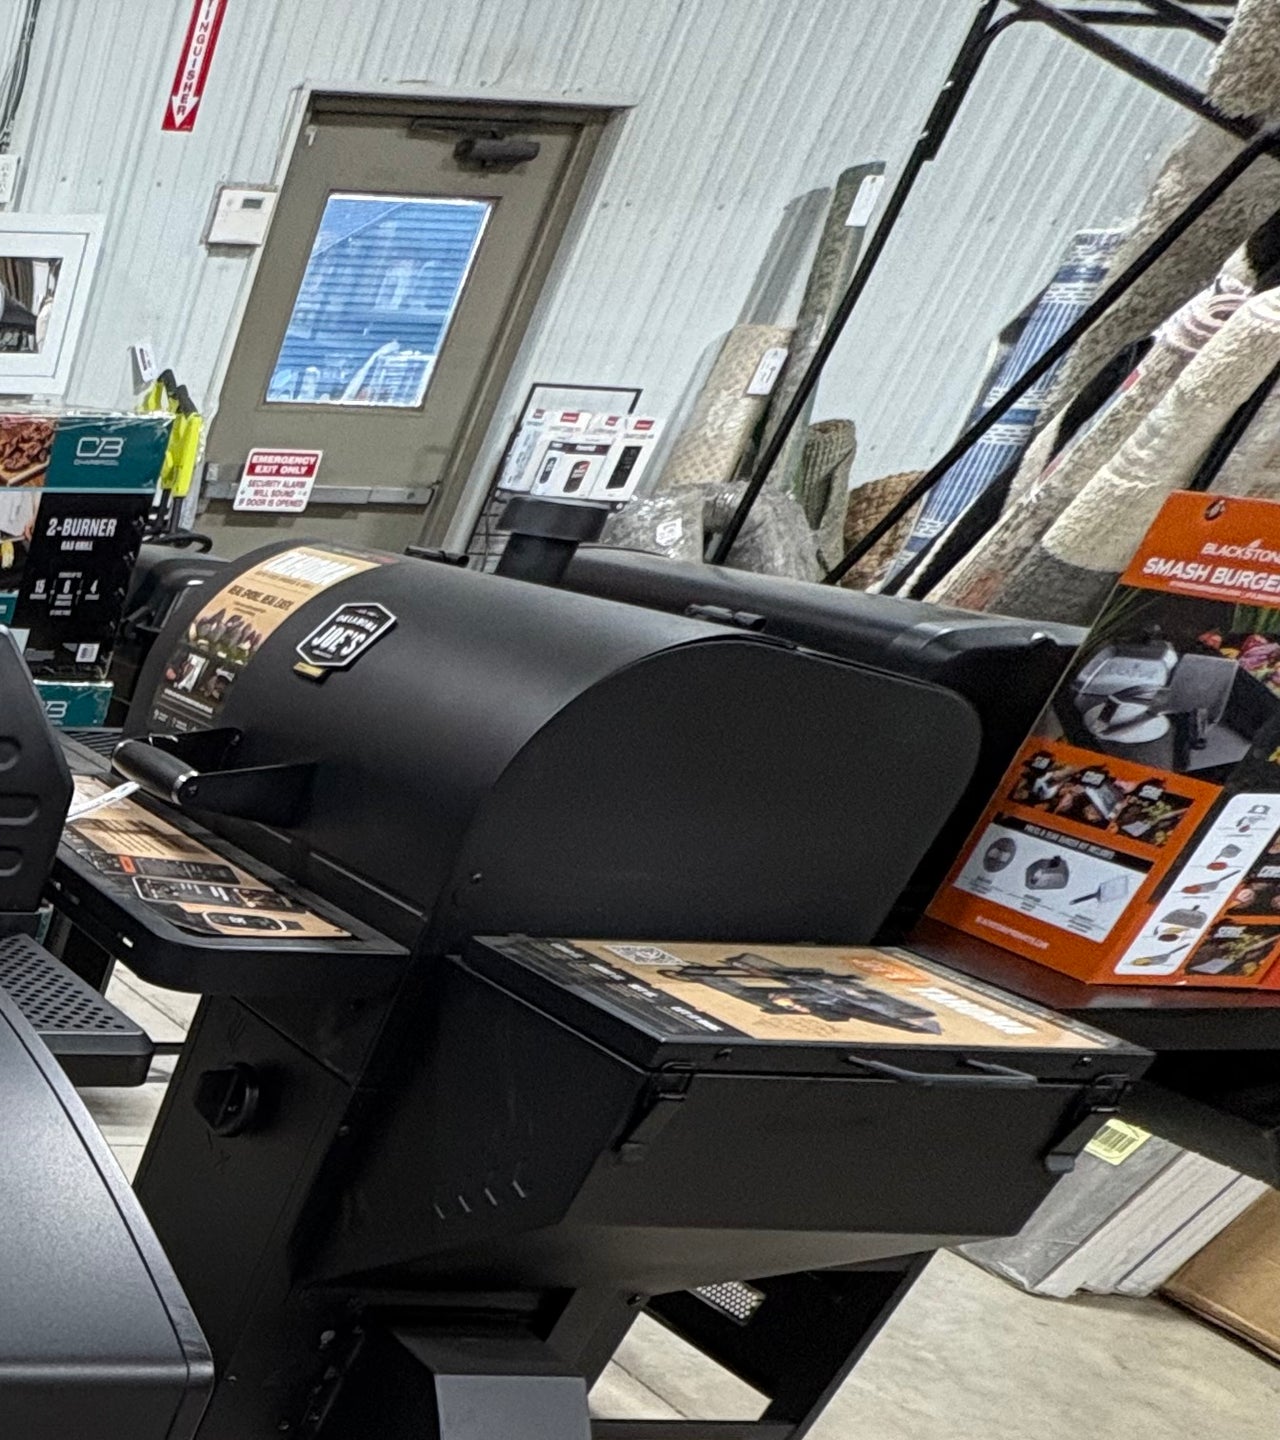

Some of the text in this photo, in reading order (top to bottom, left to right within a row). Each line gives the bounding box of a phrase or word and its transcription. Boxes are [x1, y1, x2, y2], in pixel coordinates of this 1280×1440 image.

[251, 454, 317, 465] EMERGENCY
[254, 465, 308, 475] EXIT ONLY
[247, 480, 307, 488] SECURITY ALARM
[253, 489, 296, 498] WILL SOUND
[276, 499, 304, 507] OPENED
[46, 518, 118, 537] 2-BURNER
[60, 540, 74, 550] GAS
[1201, 541, 1280, 564] BLACKSTON
[1142, 556, 1211, 582] SMASH
[1209, 567, 1280, 594] BURGE
[311, 625, 367, 657] JOE'S
